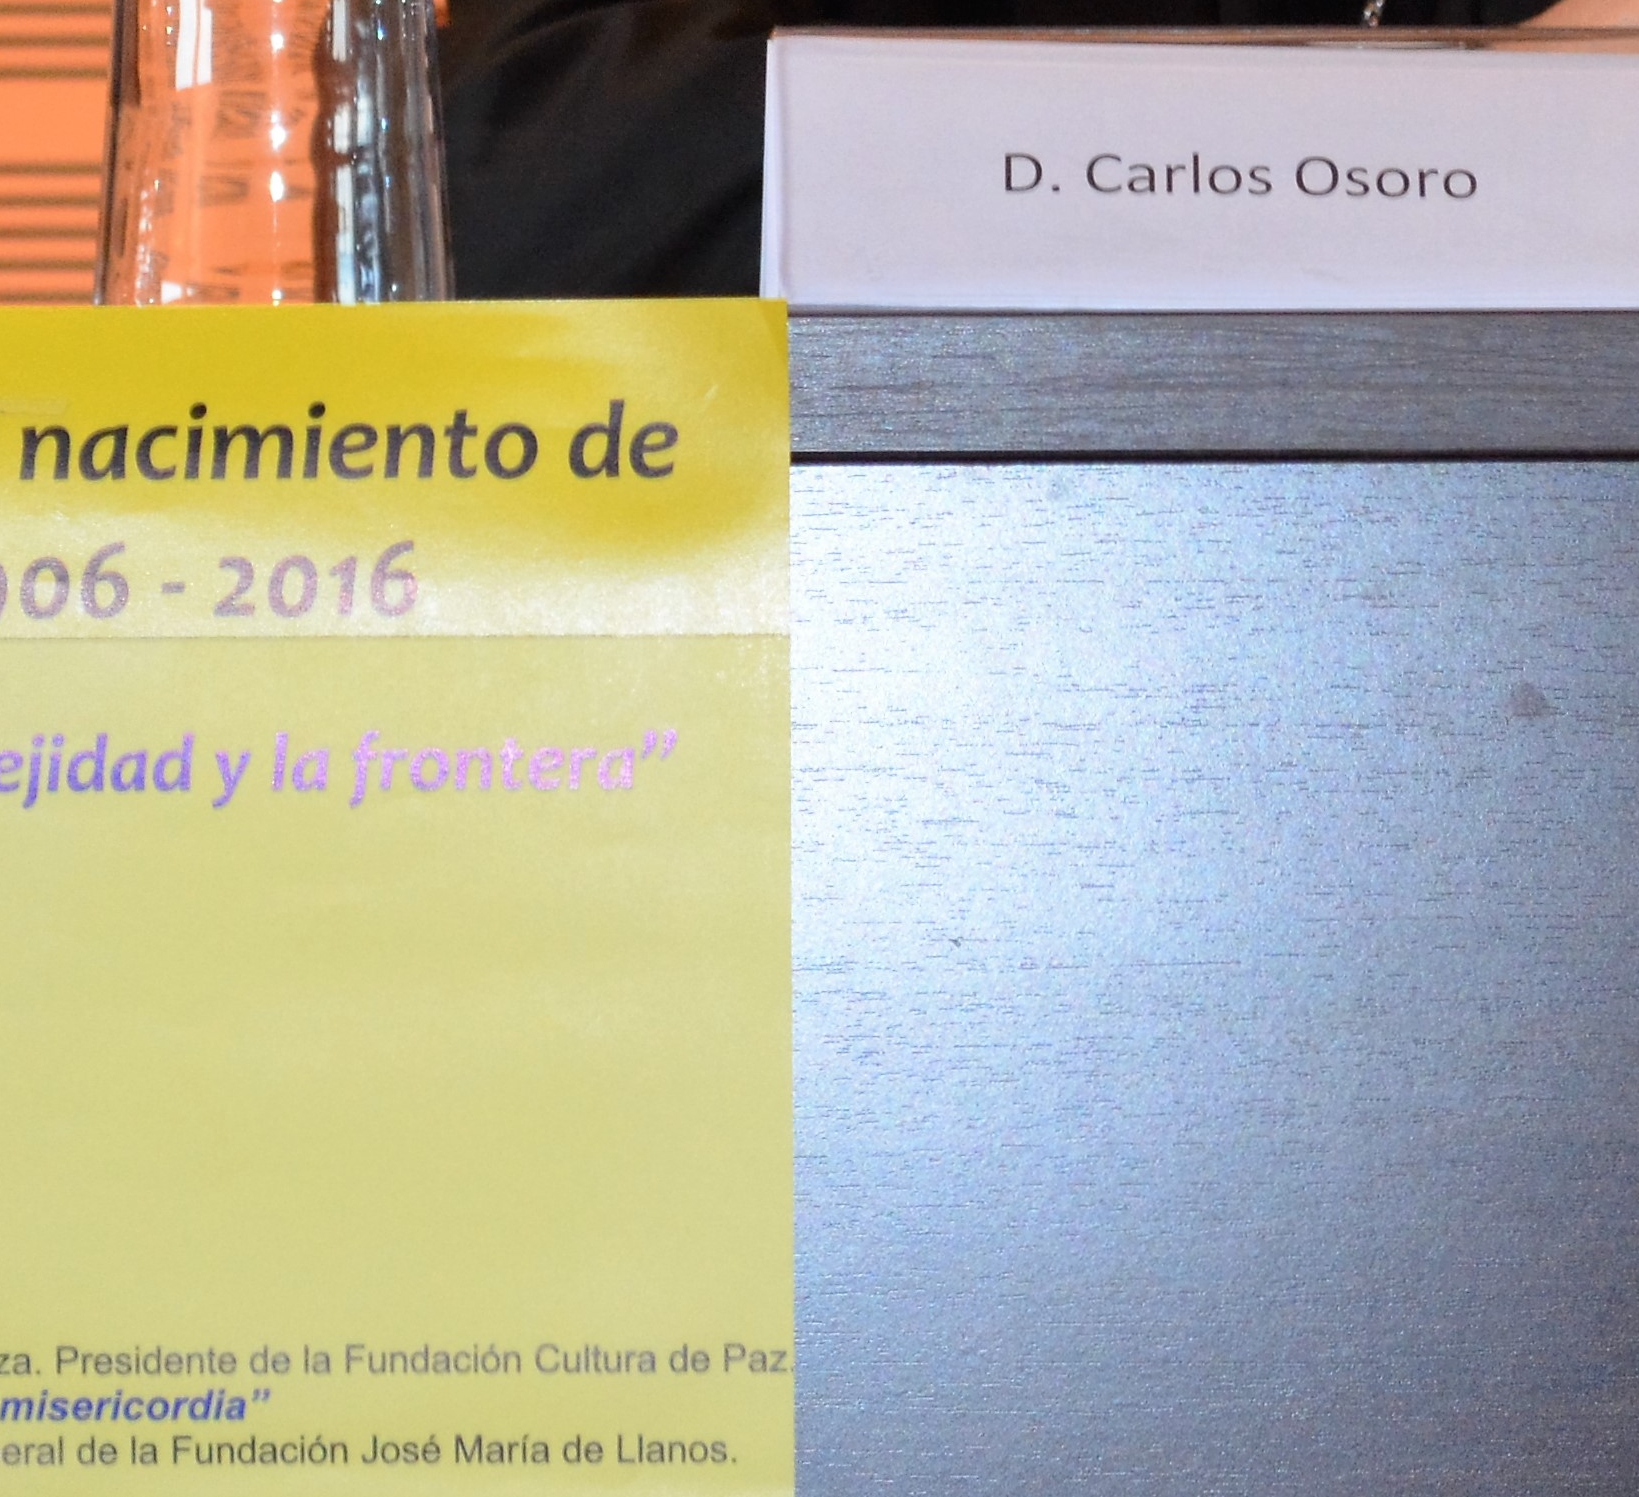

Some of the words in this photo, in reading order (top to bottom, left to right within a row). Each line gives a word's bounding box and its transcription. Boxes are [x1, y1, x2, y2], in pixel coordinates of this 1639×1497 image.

[1005, 153, 1060, 192] D.
[1086, 153, 1272, 195] Carlos
[1295, 157, 1477, 199] Osoro
[21, 402, 538, 481] nacimiento
[569, 400, 678, 479] de
[161, 582, 186, 594] -
[214, 540, 415, 617] 2016
[212, 751, 251, 809] y
[272, 733, 329, 792] la
[56, 1345, 237, 1375] Presidente
[249, 1345, 291, 1375] de
[304, 1345, 331, 1375] la
[345, 1343, 522, 1375] Fundación
[535, 1343, 657, 1374] Cultura
[668, 1344, 711, 1374] de
[77, 1436, 118, 1466] de
[131, 1436, 158, 1465] la
[172, 1435, 349, 1465] Fundación
[361, 1434, 441, 1464] José
[454, 1434, 550, 1464] María
[562, 1435, 604, 1464] de
[617, 1434, 736, 1464] Llanos.
